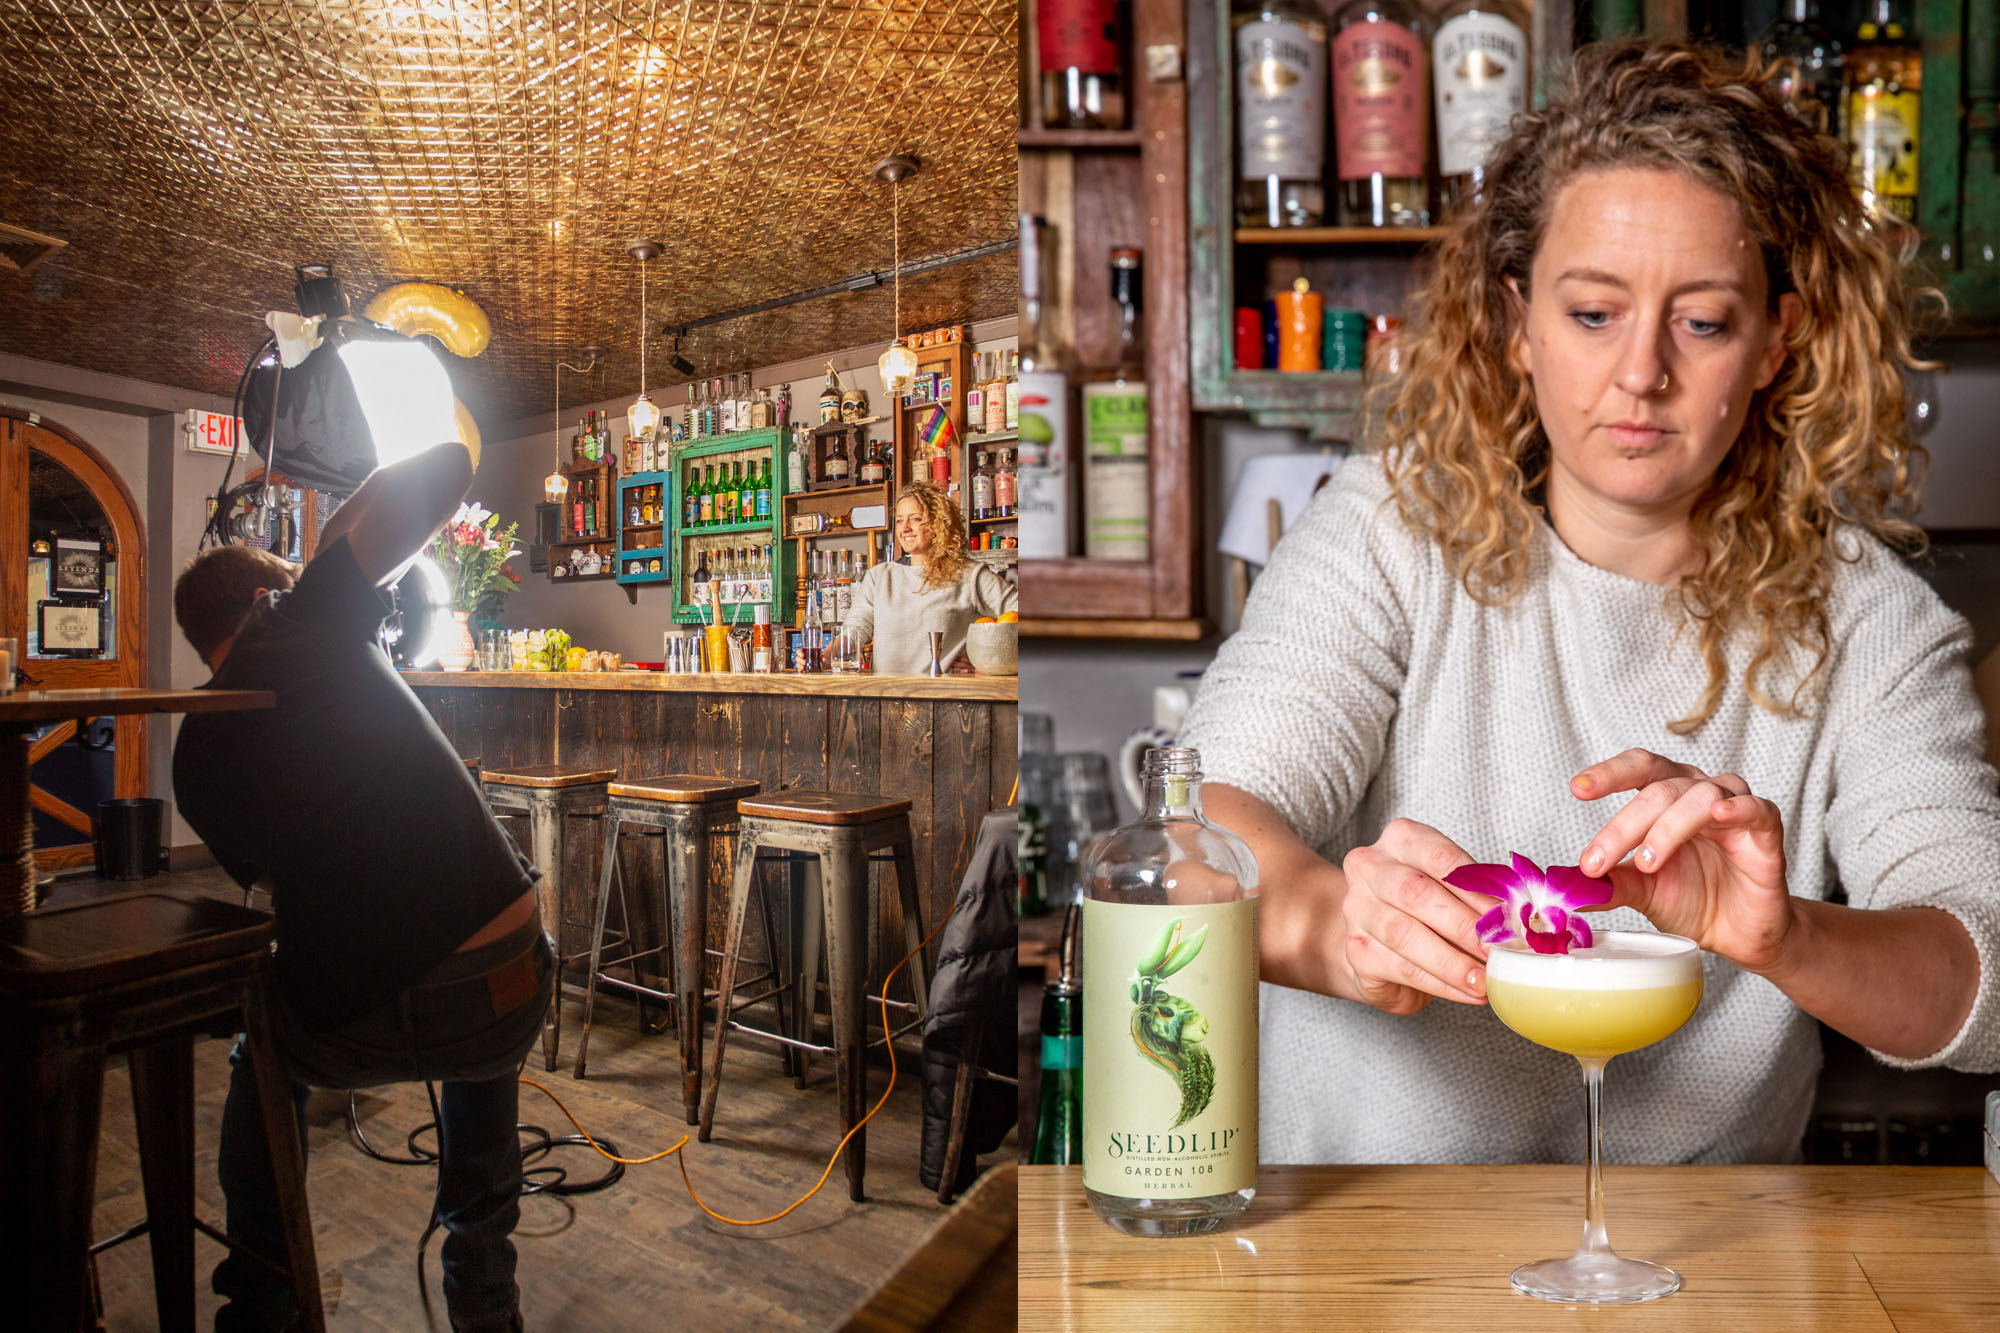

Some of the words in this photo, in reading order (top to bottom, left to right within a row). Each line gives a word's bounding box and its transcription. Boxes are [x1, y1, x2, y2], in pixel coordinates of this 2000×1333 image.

[207, 414, 243, 449] EXIT
[58, 565, 100, 574] LEYENDA
[1109, 1129, 1236, 1159] SEEDLIP
[1210, 1151, 1230, 1159] SPIRITS
[1125, 1166, 1183, 1177] GARDEN
[1191, 1164, 1214, 1175] 108
